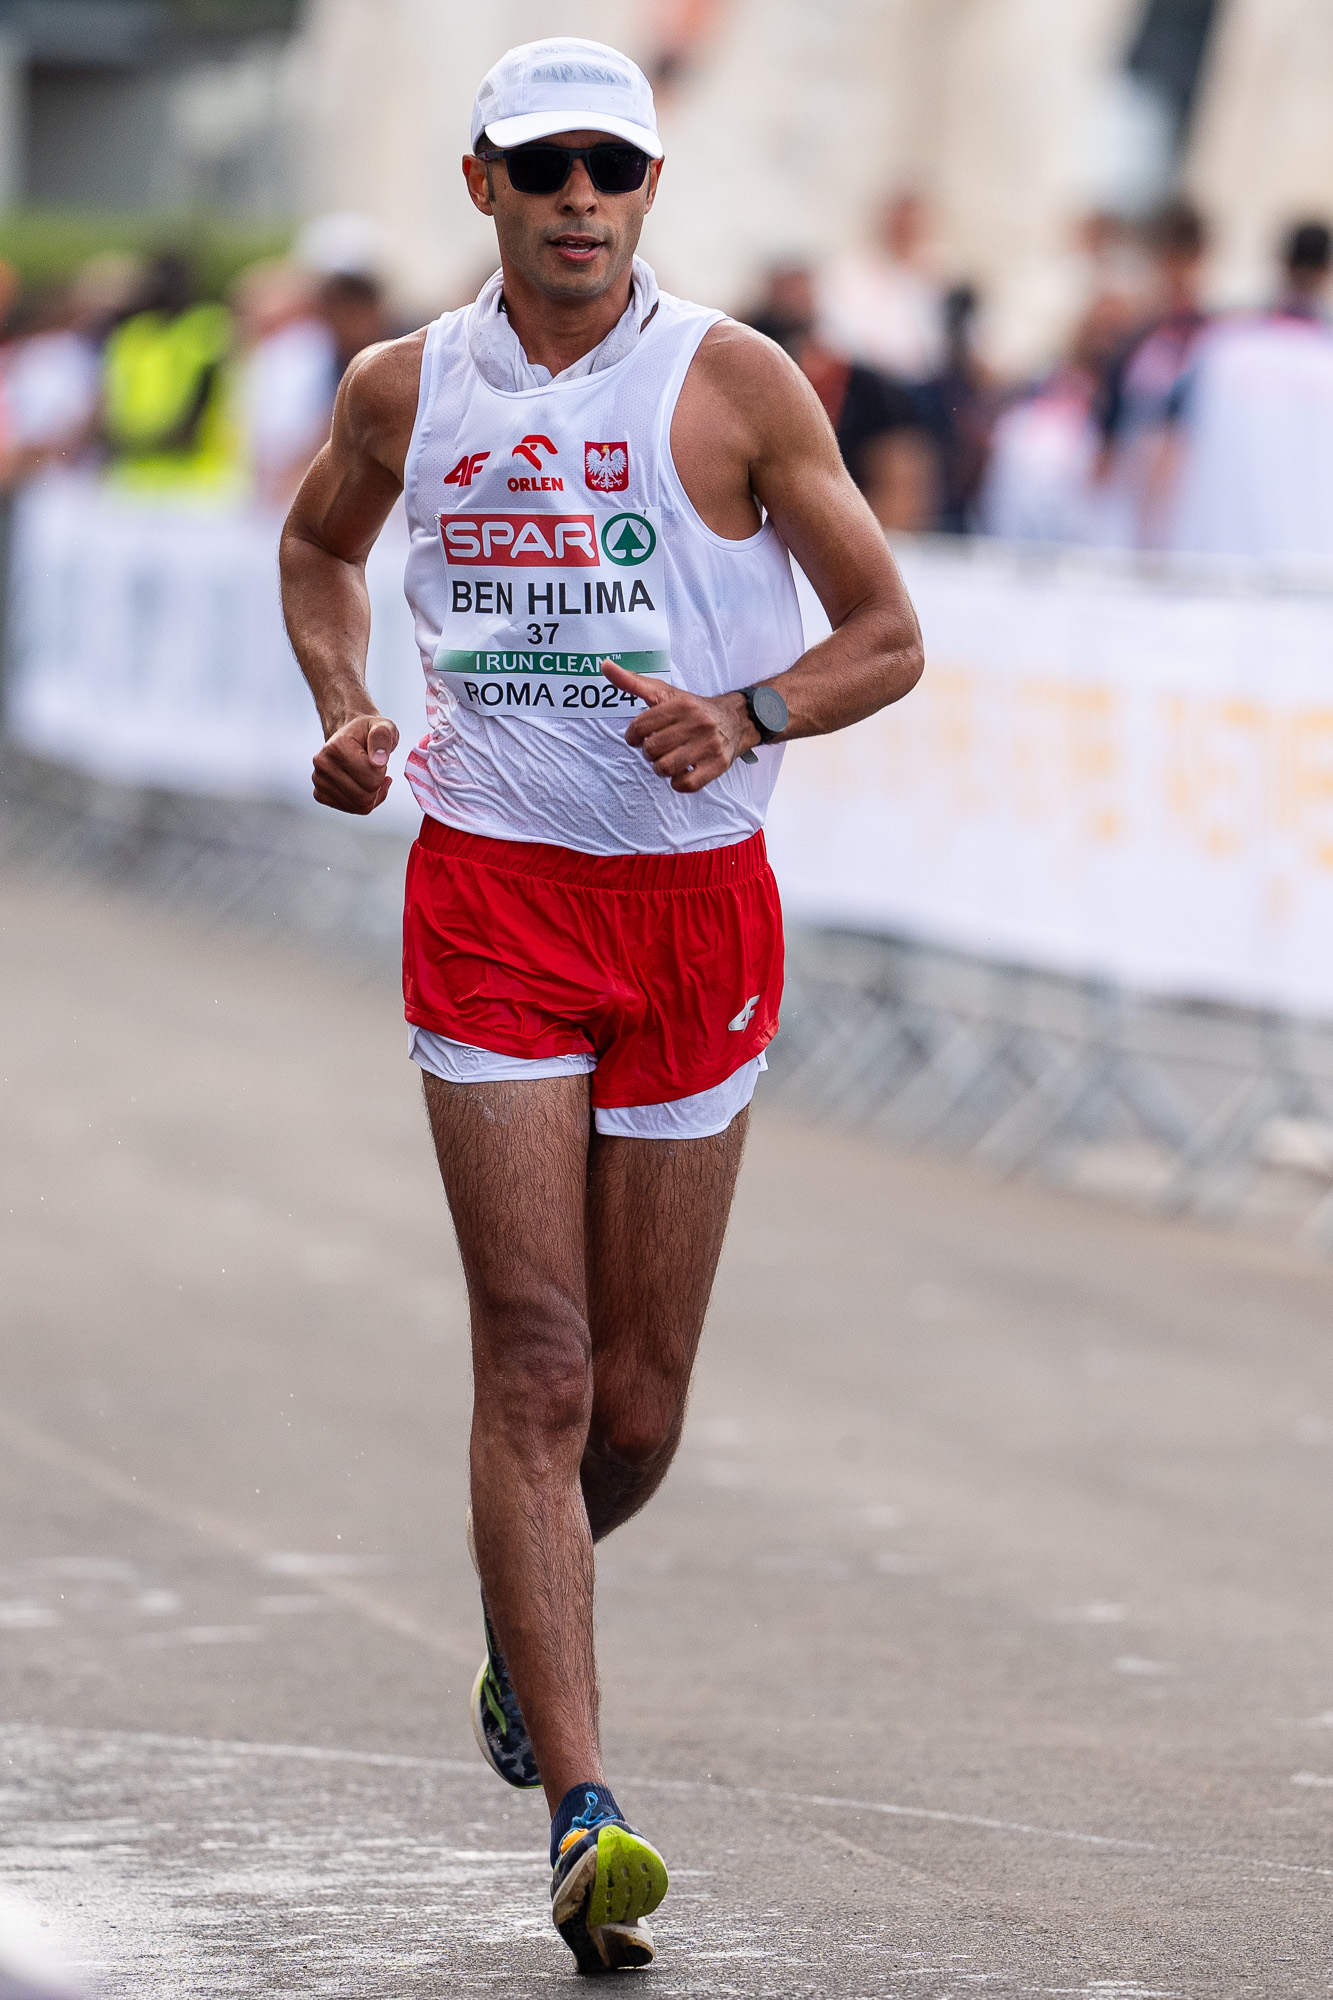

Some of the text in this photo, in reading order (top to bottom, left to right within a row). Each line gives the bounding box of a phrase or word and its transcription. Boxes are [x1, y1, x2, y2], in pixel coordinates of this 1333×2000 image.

[444, 451, 490, 487] 4F
[507, 477, 564, 491] ORLEN
[446, 521, 596, 559] SPAR
[451, 579, 655, 615] BEN HLIMA
[526, 622, 560, 645] 37
[475, 653, 481, 671] I
[486, 653, 534, 671] RUN
[464, 681, 555, 708] ROMA
